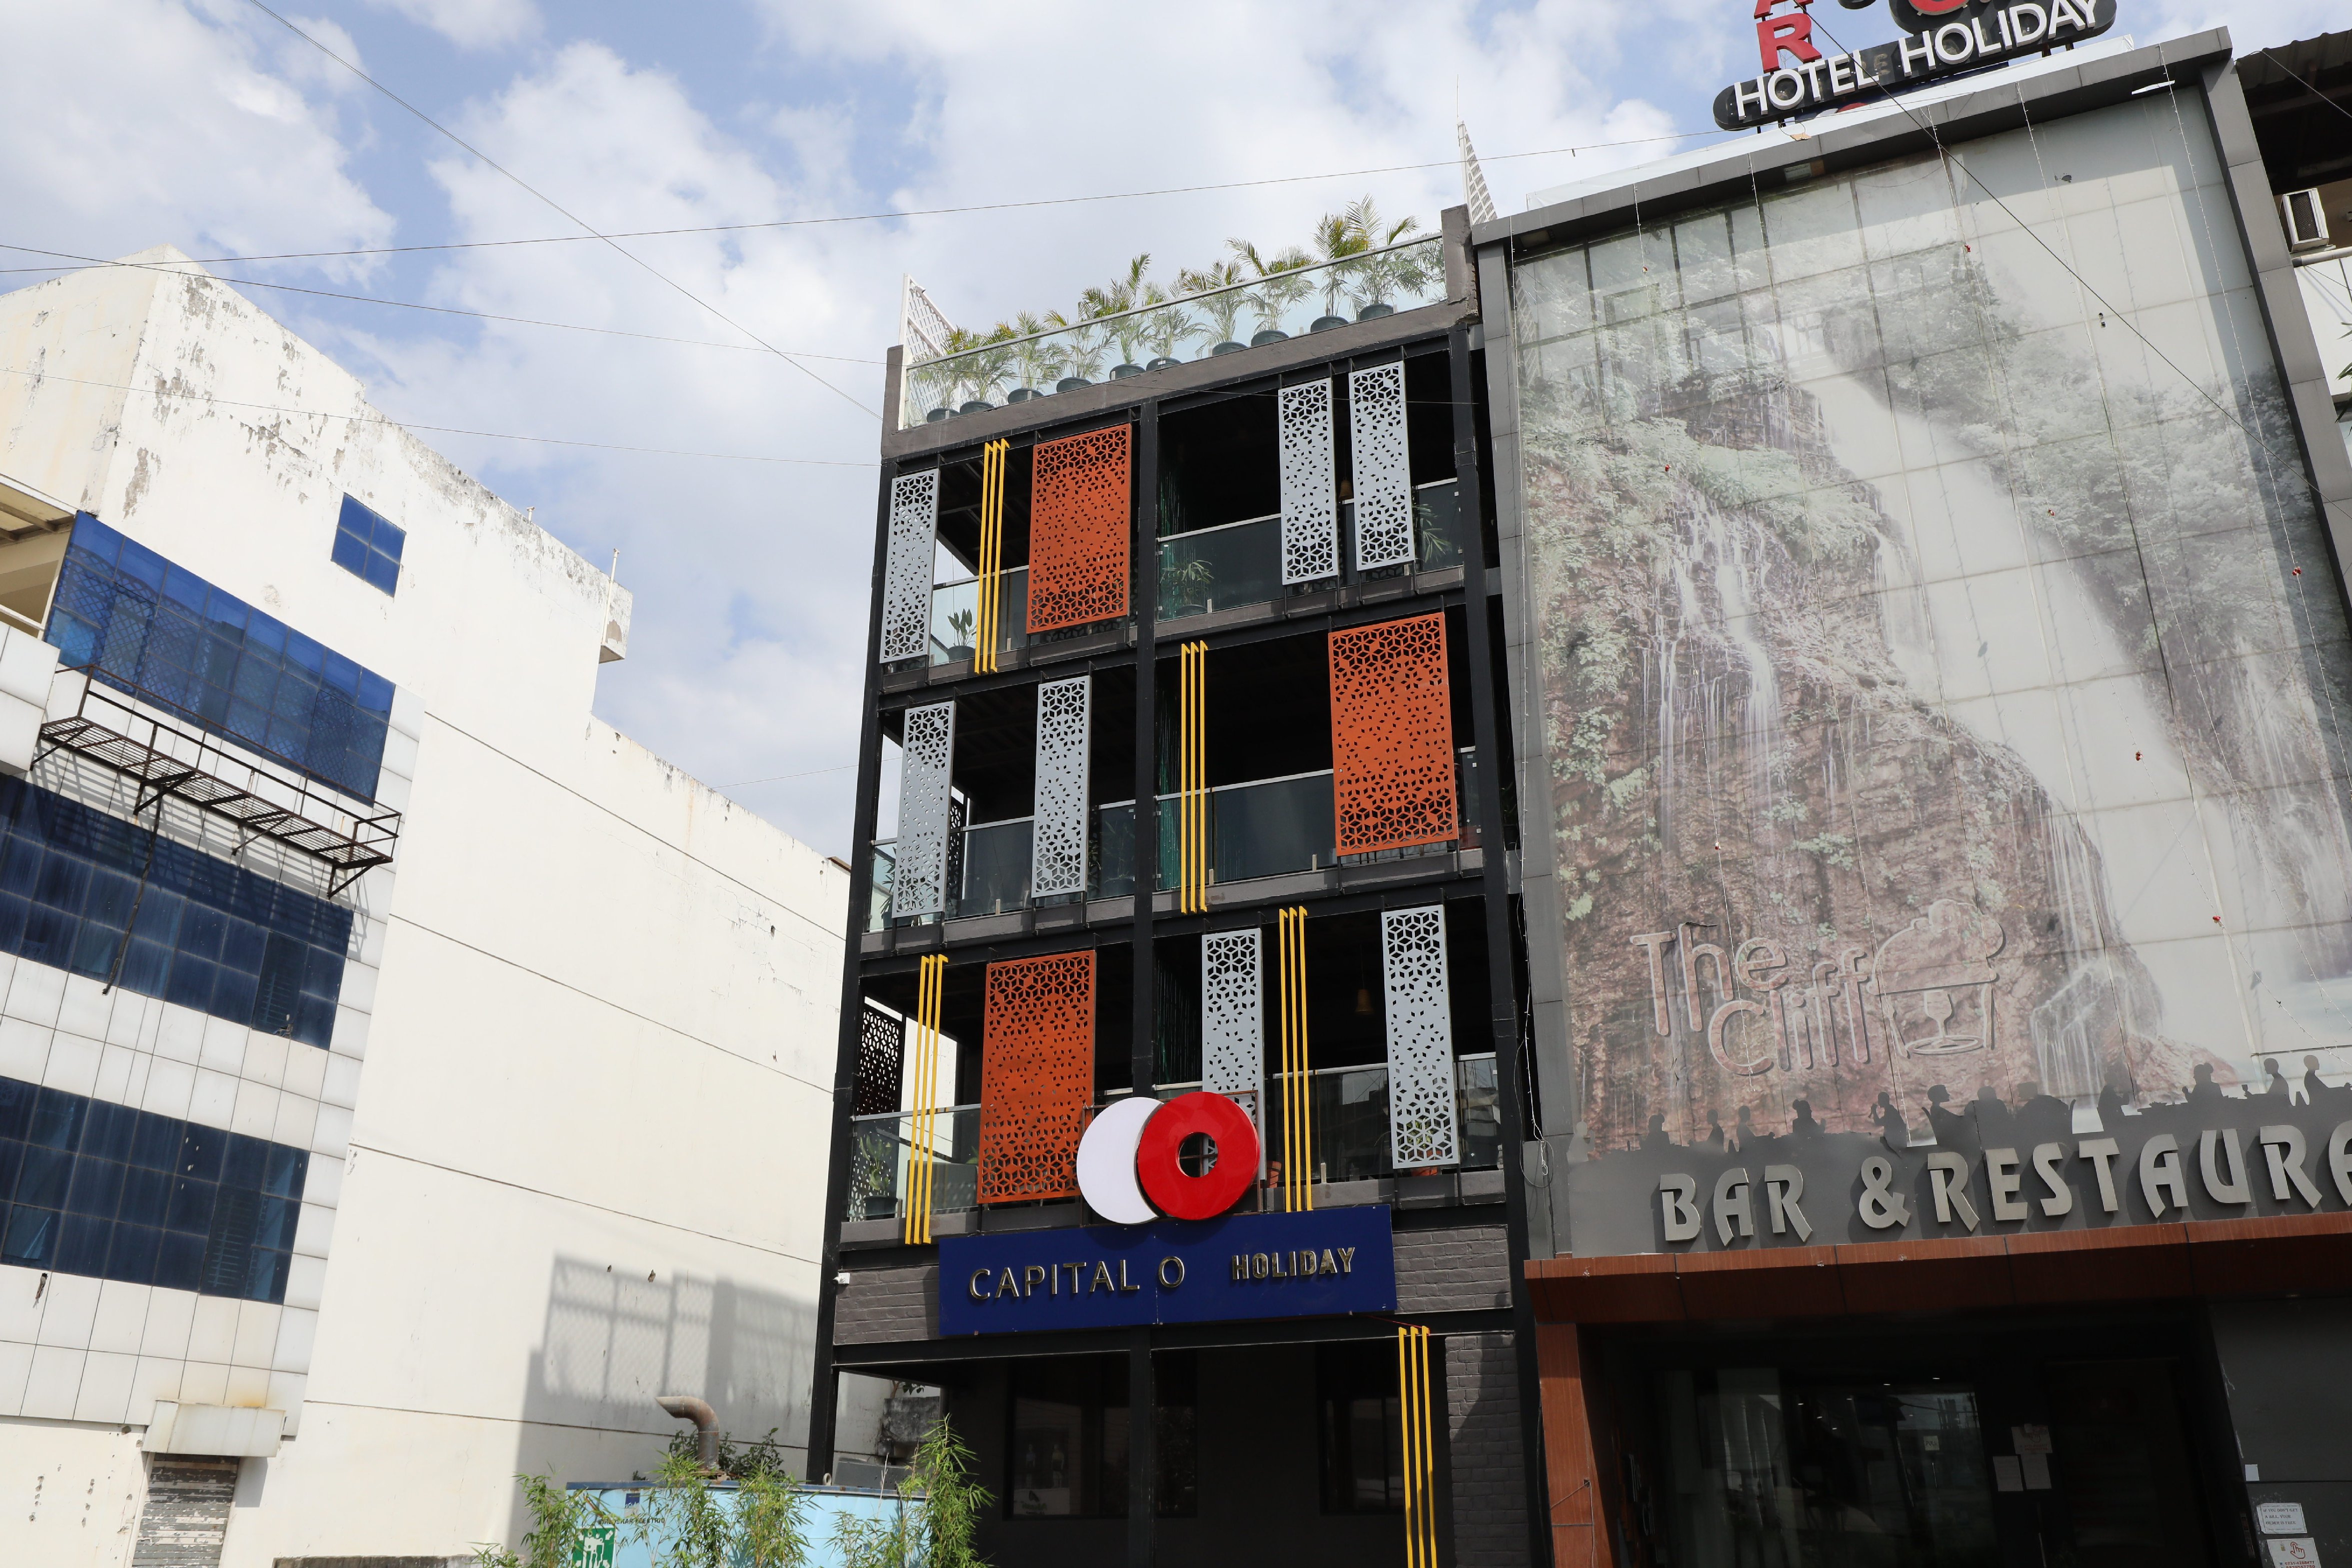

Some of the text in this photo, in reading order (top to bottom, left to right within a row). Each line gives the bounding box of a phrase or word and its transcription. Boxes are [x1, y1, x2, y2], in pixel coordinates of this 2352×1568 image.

[1733, 0, 2098, 121] HOTEL HOLIDAY
[1630, 922, 1788, 1036] The
[1708, 948, 1871, 1076] Cliff
[1659, 1164, 1813, 1246] BAR
[1858, 1156, 1911, 1230] &
[969, 1246, 1356, 1300] CAPITAL O HOLIDAY
